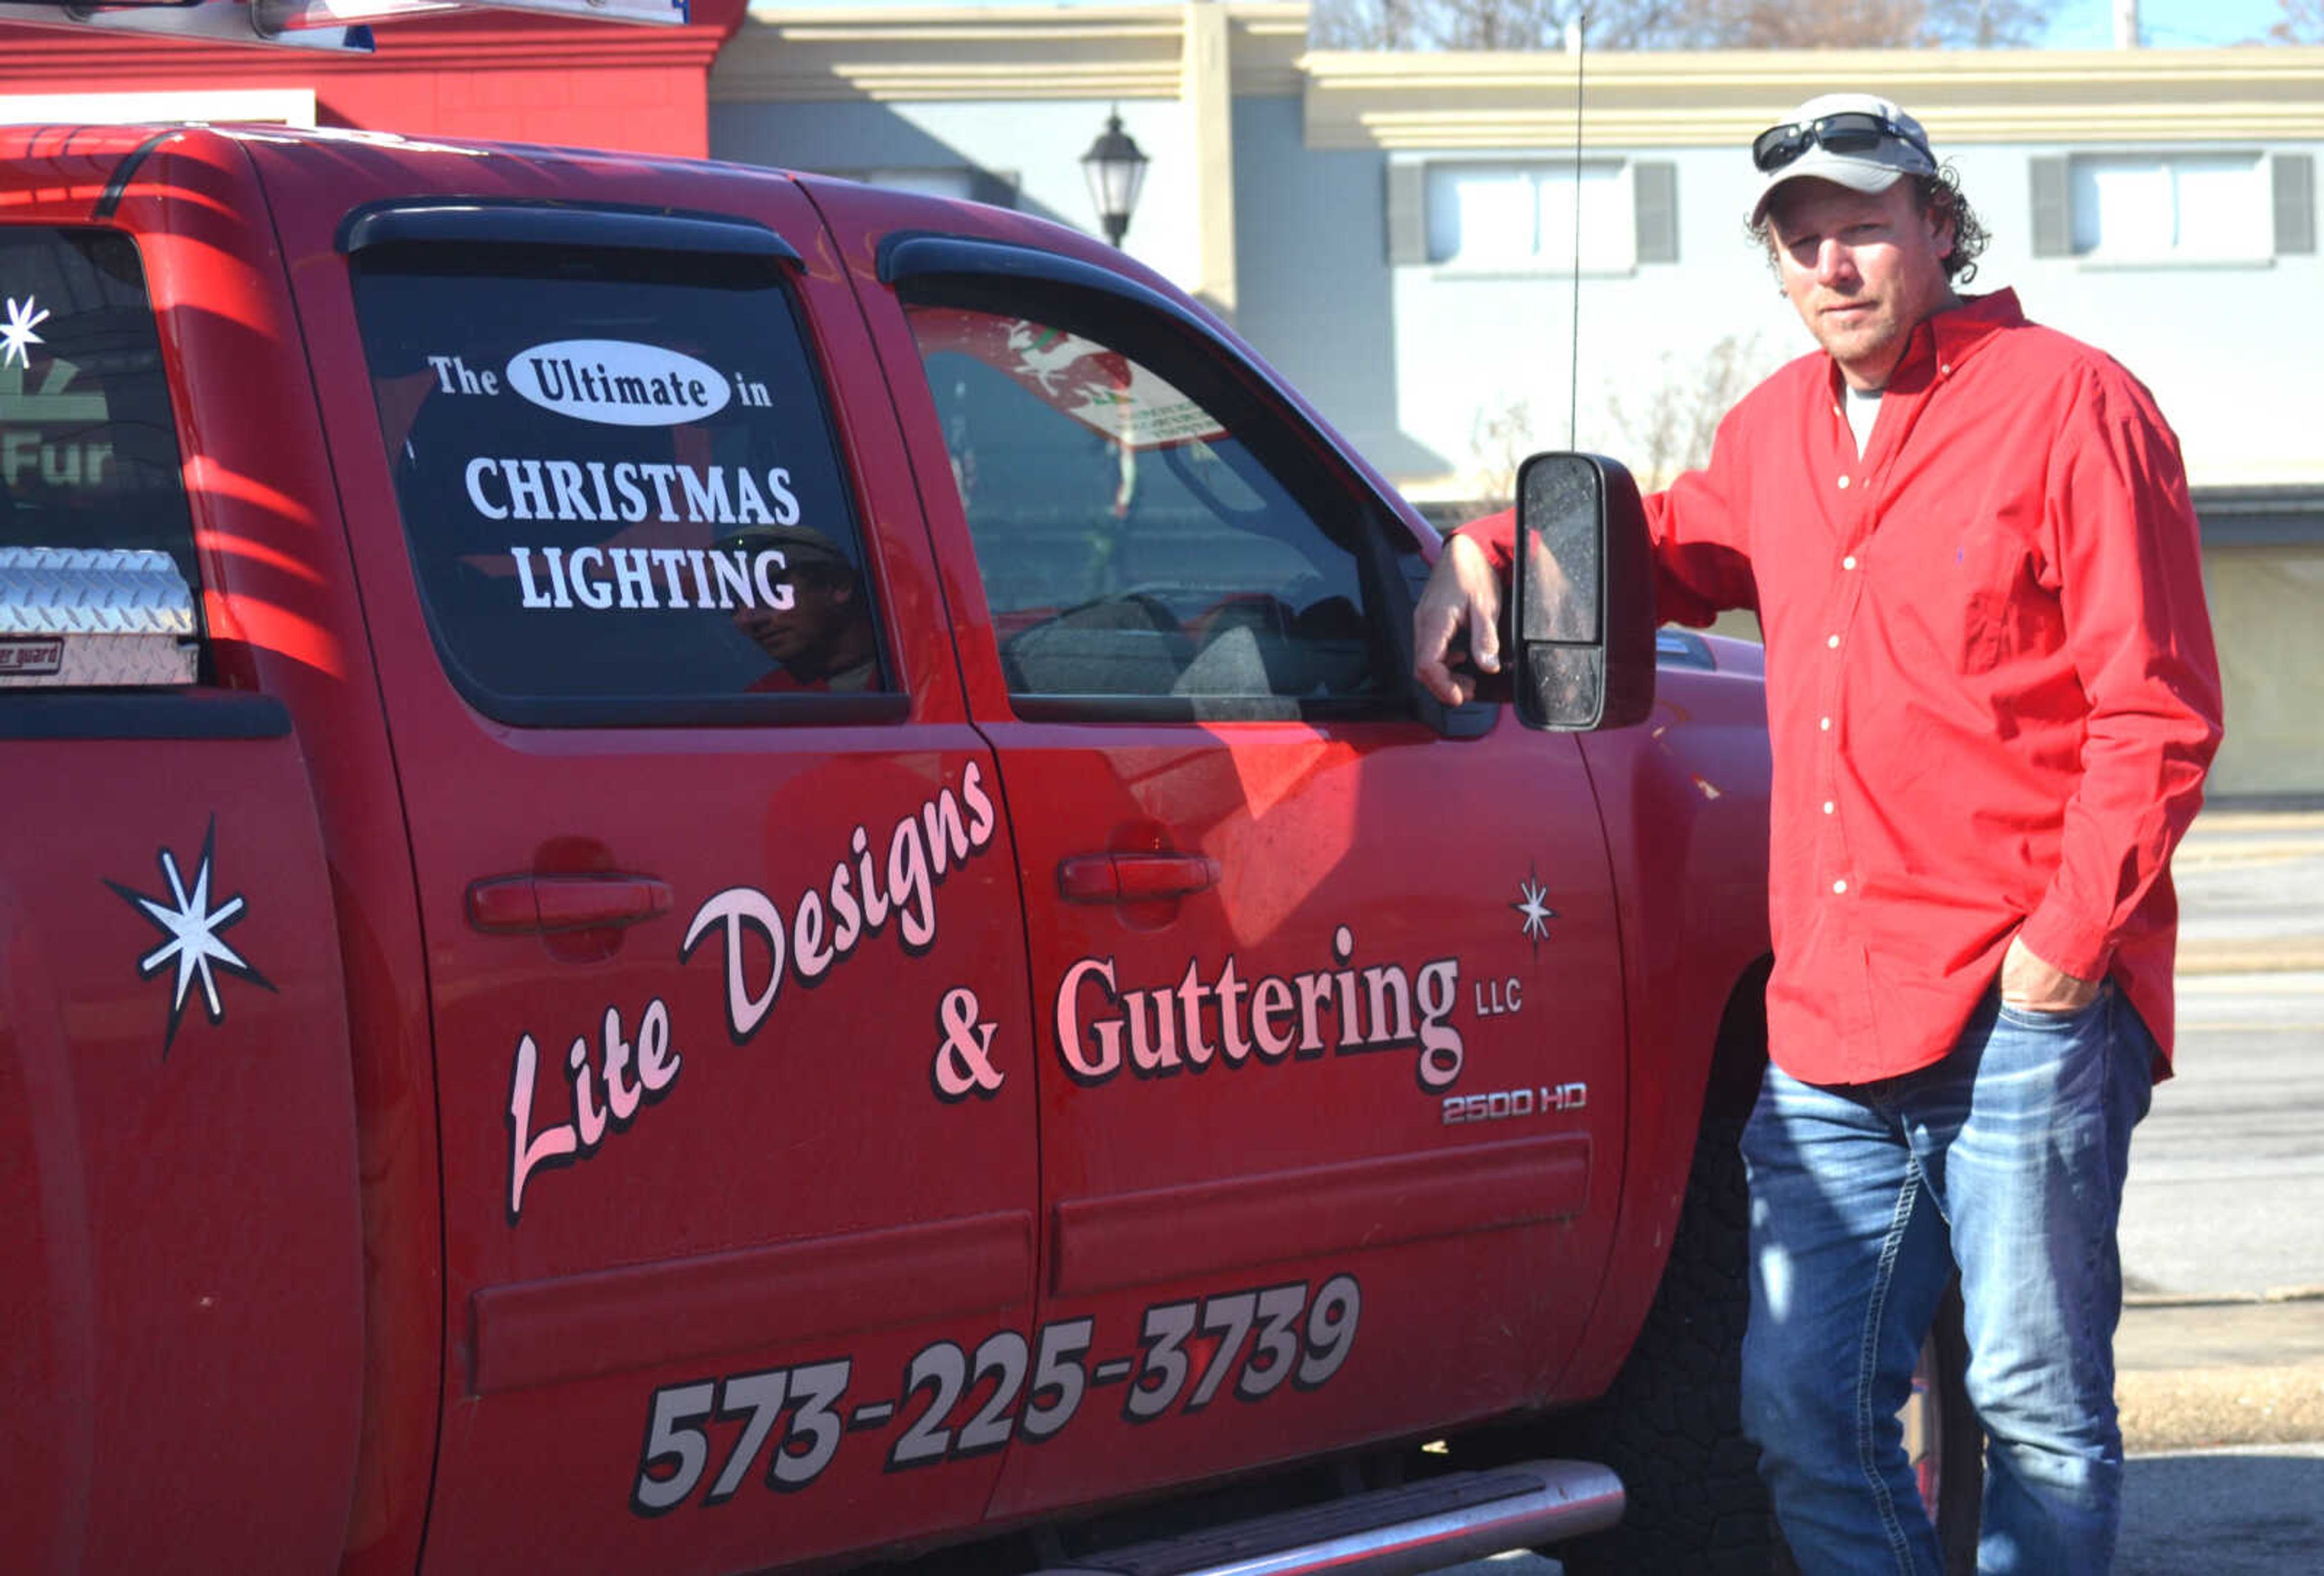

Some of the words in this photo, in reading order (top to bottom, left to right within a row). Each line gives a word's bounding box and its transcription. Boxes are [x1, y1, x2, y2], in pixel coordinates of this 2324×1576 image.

[428, 356, 499, 396] The
[529, 358, 709, 407] Ultimate
[737, 373, 773, 407] in
[465, 457, 801, 526] CHRISTMAS
[510, 547, 796, 611] LIGHTING
[507, 997, 681, 1219] Lite
[681, 759, 996, 1041] Designs
[934, 987, 1005, 1098] &
[1054, 924, 1464, 1091] Guttering
[1475, 977, 1523, 1017] LLC
[1442, 1088, 1533, 1125] 2500
[1540, 1082, 1587, 1112] HD
[633, 1274, 1360, 1515] 573-225-3739
